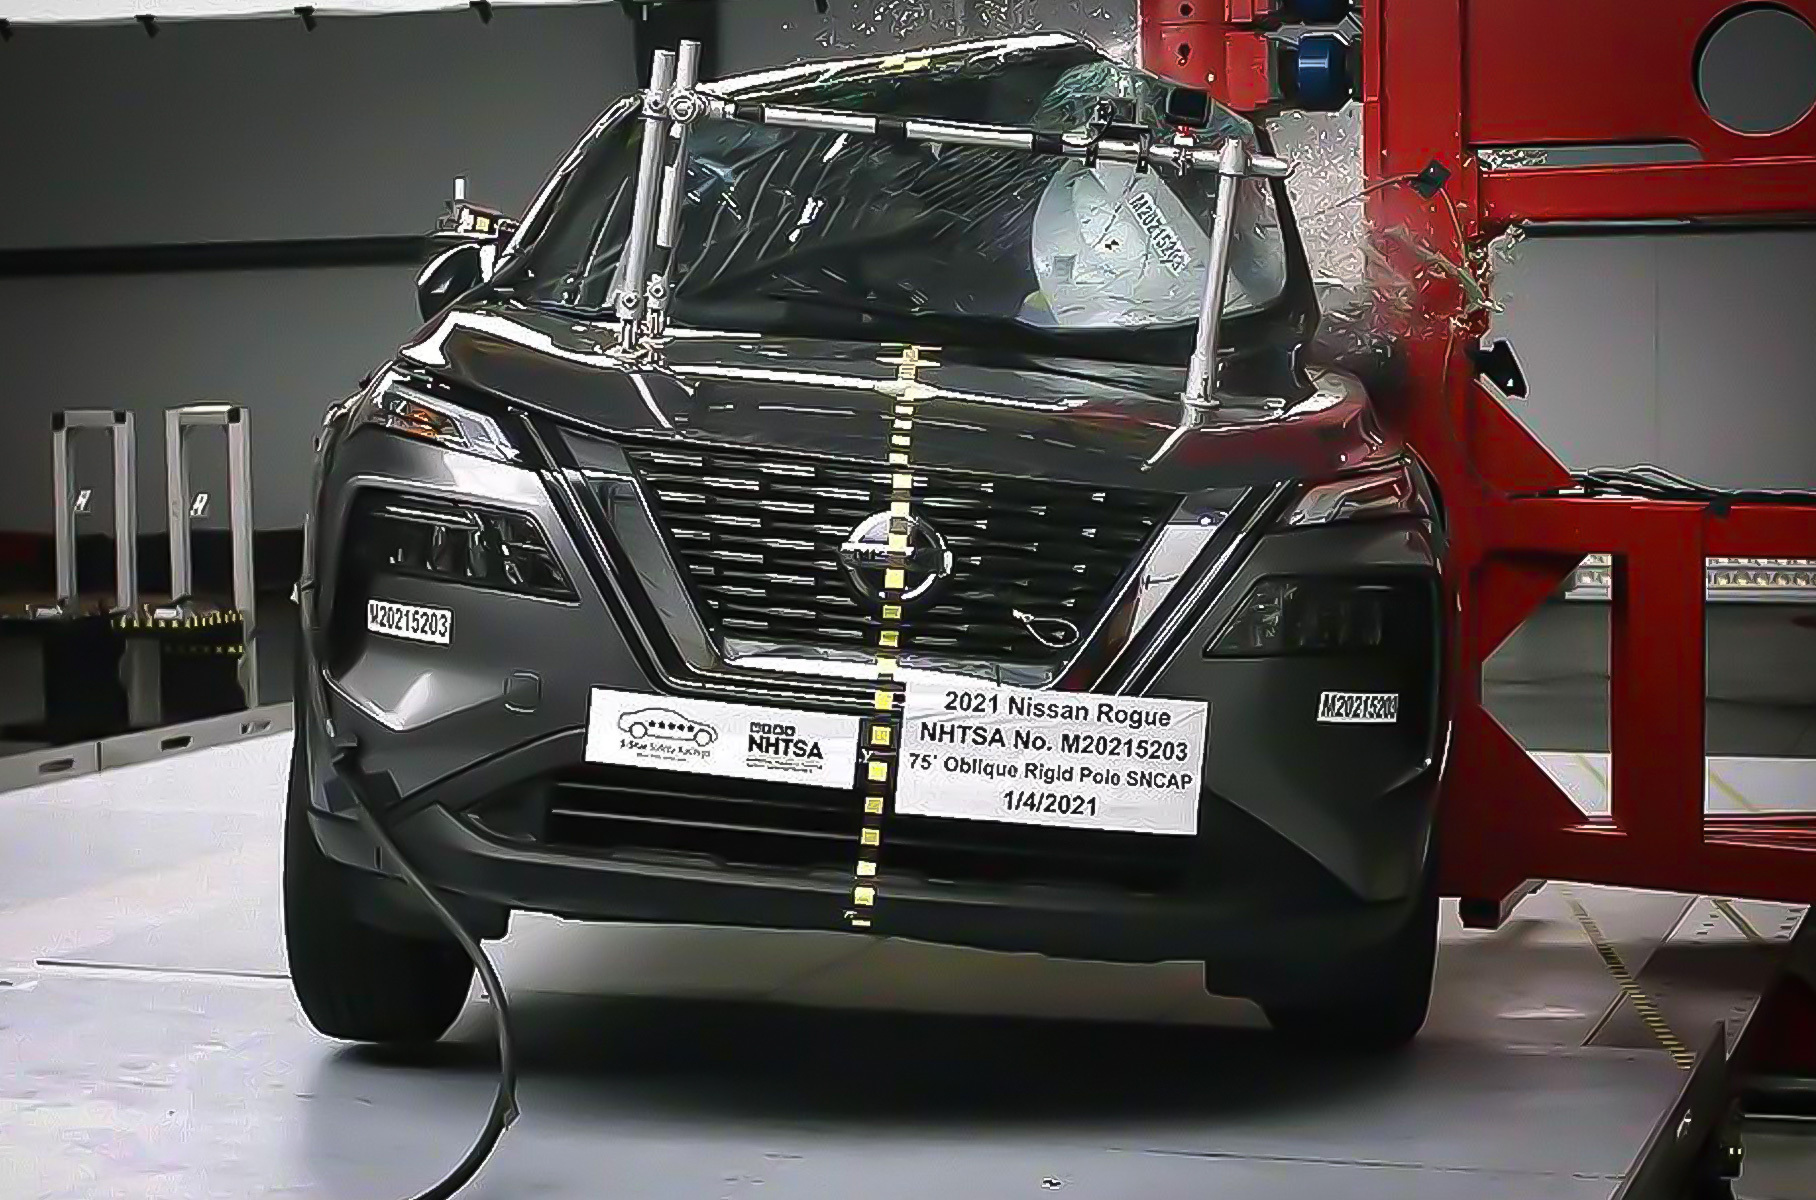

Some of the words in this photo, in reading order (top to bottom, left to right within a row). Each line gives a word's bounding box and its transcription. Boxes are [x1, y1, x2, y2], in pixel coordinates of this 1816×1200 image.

[945, 691, 999, 714] 2021
[1008, 697, 1088, 721] Nissan
[1097, 703, 1171, 728] Rogue
[748, 736, 824, 759] NHTSA
[920, 722, 1005, 747] NHTSA
[1014, 731, 1052, 752] No.
[1061, 734, 1188, 761] M20215203
[1127, 772, 1193, 792] SNCAP
[1003, 790, 1097, 815] 1/4/2021
